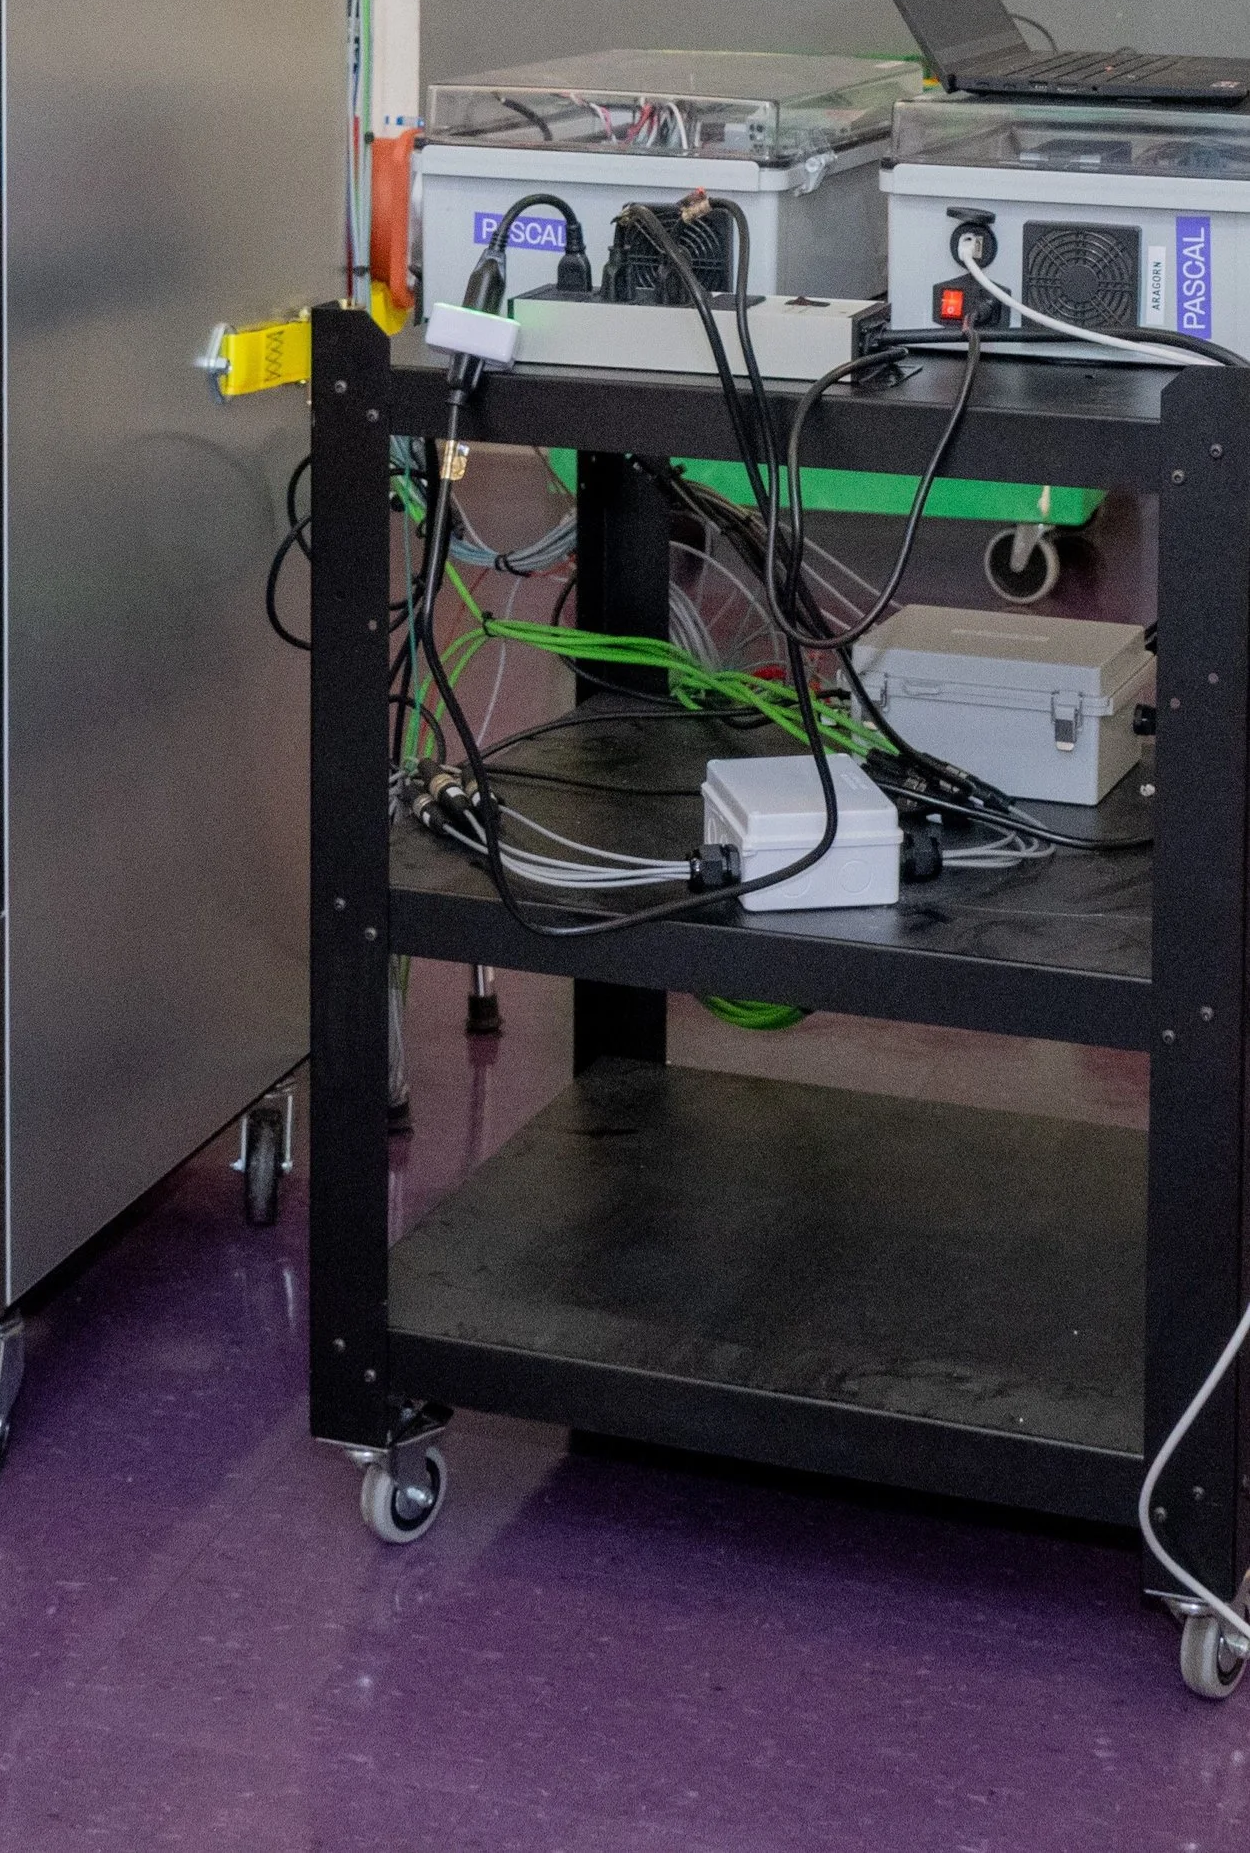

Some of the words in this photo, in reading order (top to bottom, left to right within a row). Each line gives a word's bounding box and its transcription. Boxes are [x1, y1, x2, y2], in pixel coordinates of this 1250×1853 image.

[481, 217, 566, 247] PSCAL
[1152, 261, 1162, 311] ARAGORN
[1182, 226, 1206, 329] PASCAL
